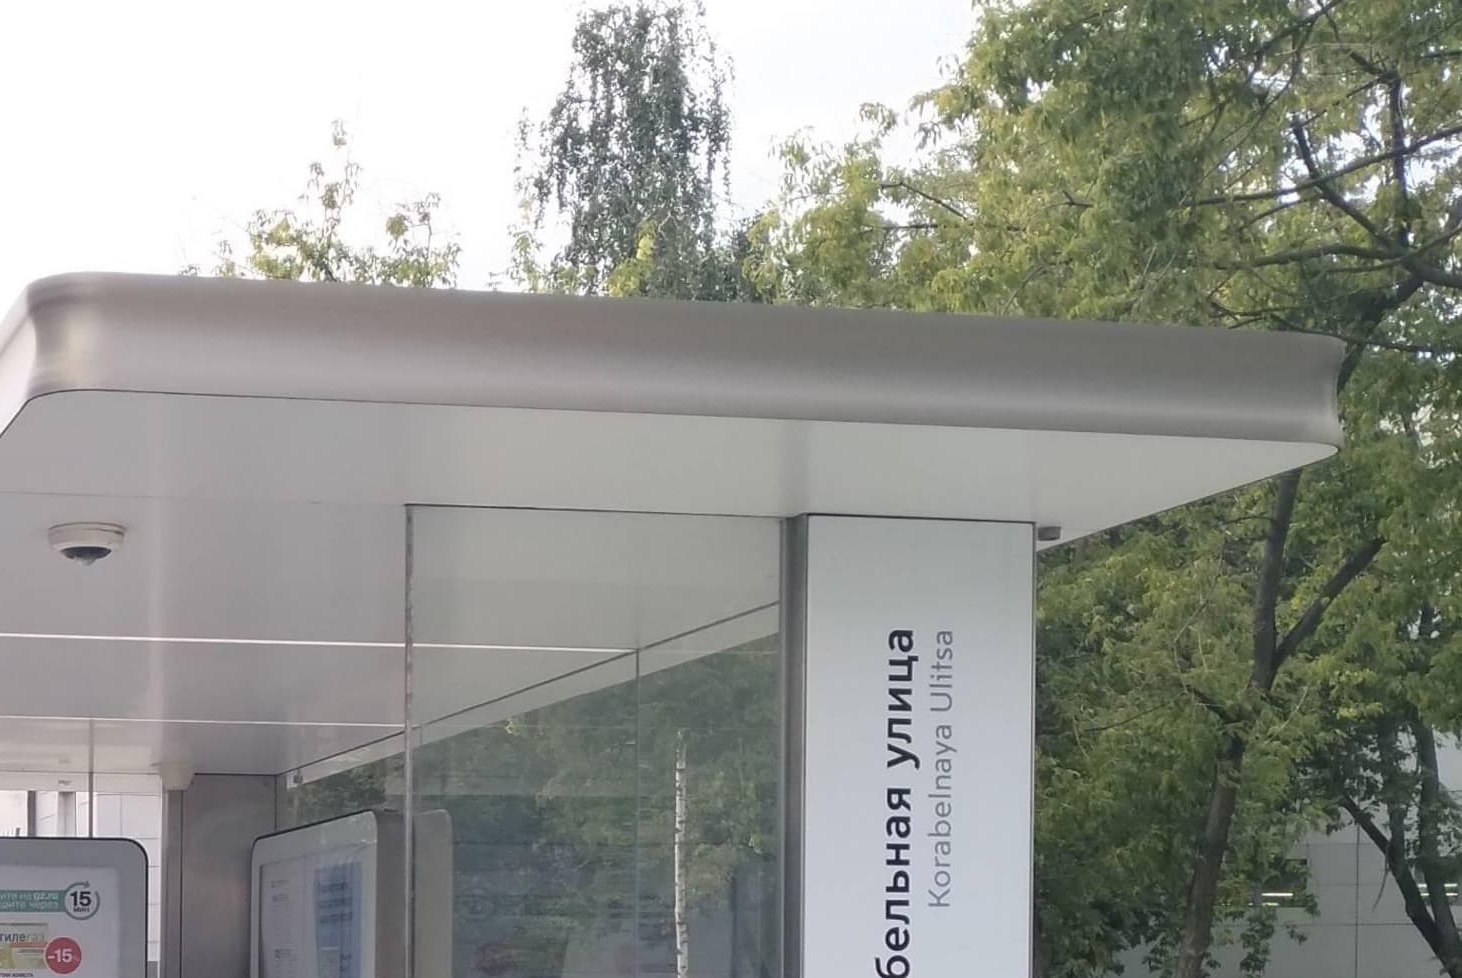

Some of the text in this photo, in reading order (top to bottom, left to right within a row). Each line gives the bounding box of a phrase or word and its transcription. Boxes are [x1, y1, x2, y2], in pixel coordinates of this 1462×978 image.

[886, 628, 920, 769] улица
[927, 629, 958, 908] Korabelnaya Ulitsa
[69, 891, 92, 907] 15
